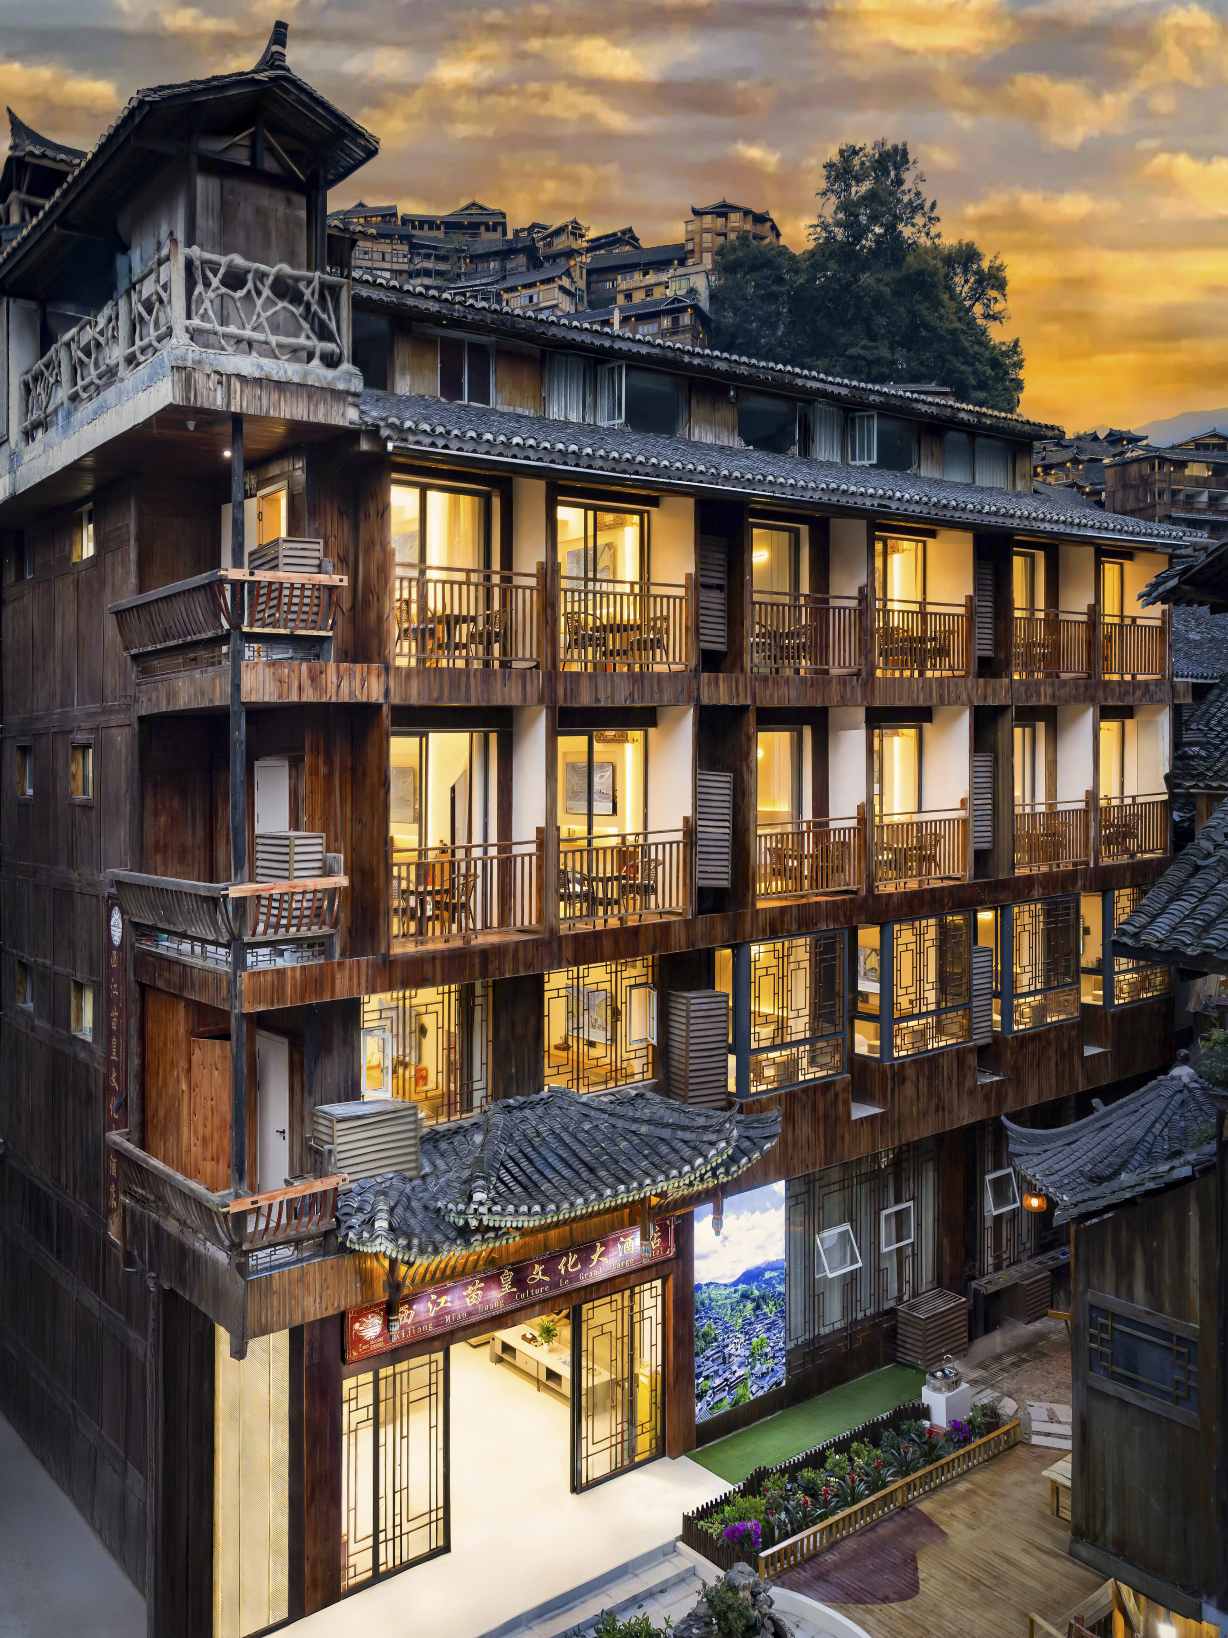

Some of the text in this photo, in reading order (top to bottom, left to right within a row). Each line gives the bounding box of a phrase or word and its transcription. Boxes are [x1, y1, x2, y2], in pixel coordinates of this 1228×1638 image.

[110, 951, 119, 1208] 西江苗皇文化酒店
[445, 1312, 467, 1324] Miao
[479, 1300, 504, 1313] Huang
[515, 1284, 549, 1300] Culture
[559, 1279, 569, 1287] Le
[579, 1267, 602, 1281] Grand
[612, 1258, 634, 1270] Large
[650, 1247, 662, 1257] tel
